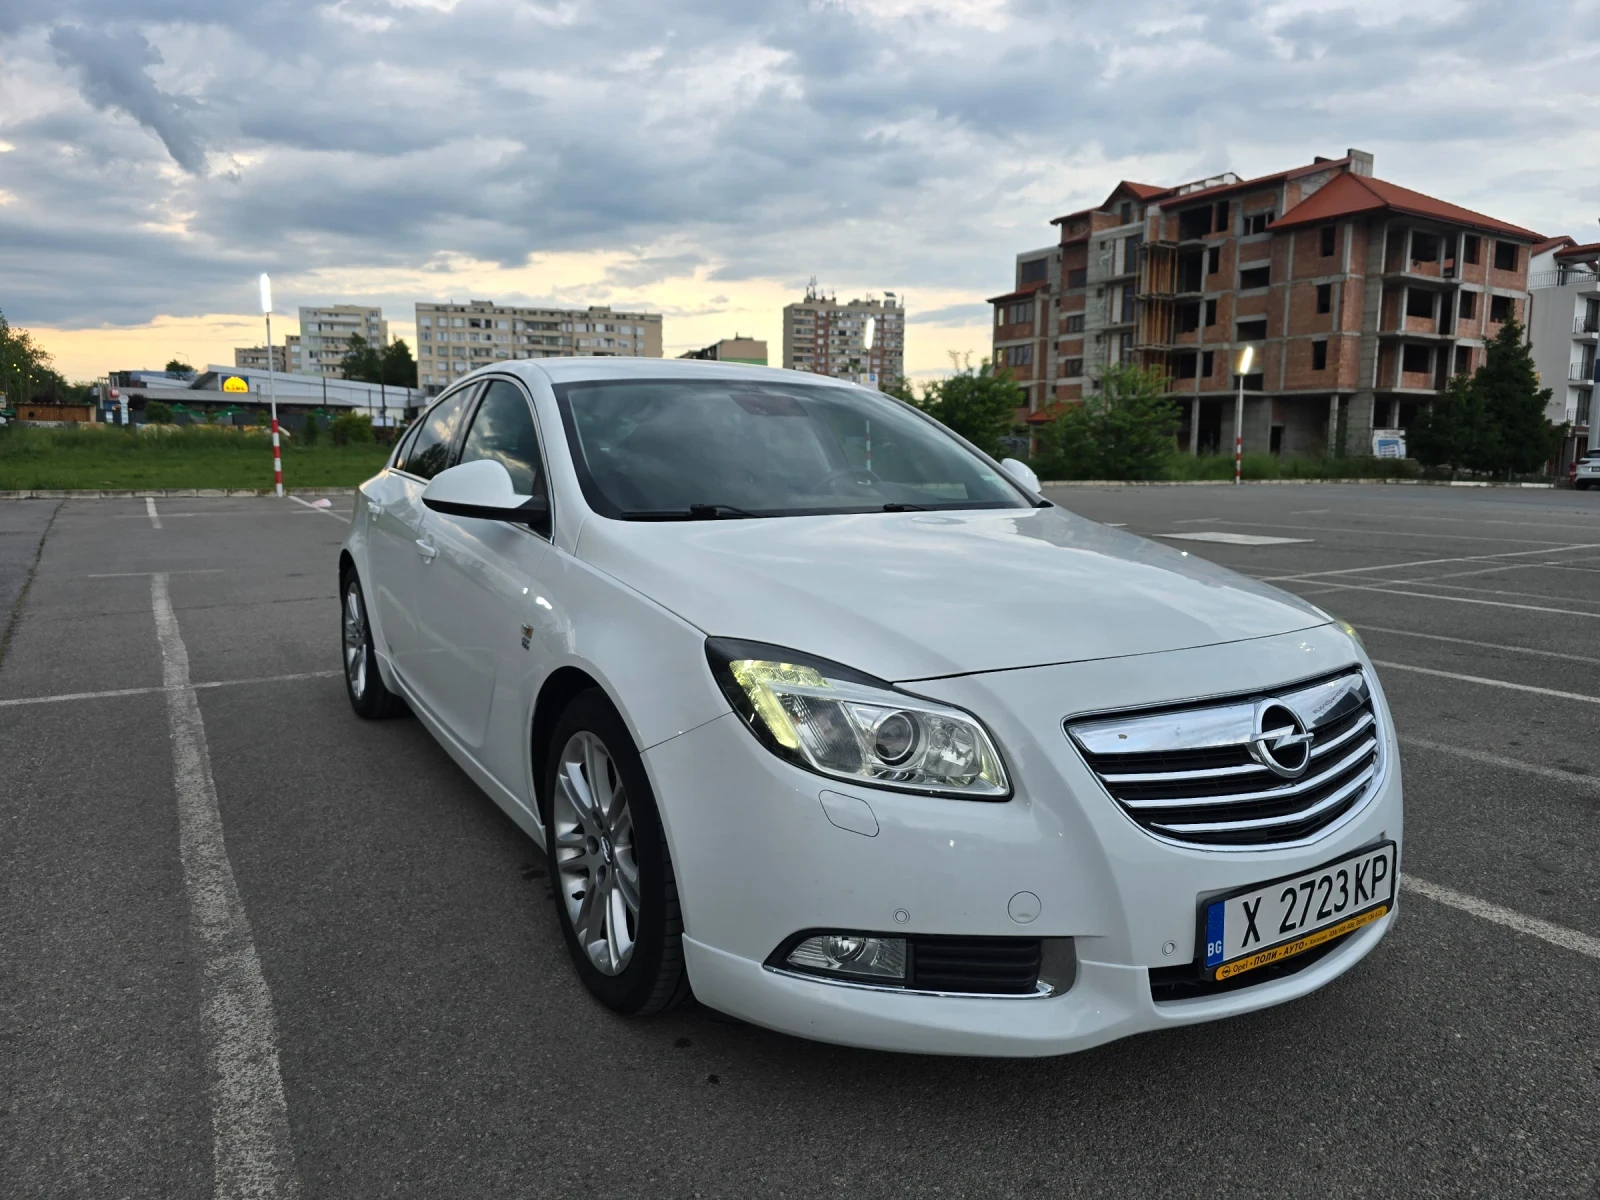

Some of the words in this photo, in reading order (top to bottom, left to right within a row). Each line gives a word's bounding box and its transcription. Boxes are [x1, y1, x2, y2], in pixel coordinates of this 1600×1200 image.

[1241, 897, 1261, 948] X
[1279, 869, 1348, 934] 2723
[1207, 940, 1222, 957] BG
[1233, 961, 1248, 973] Opel
